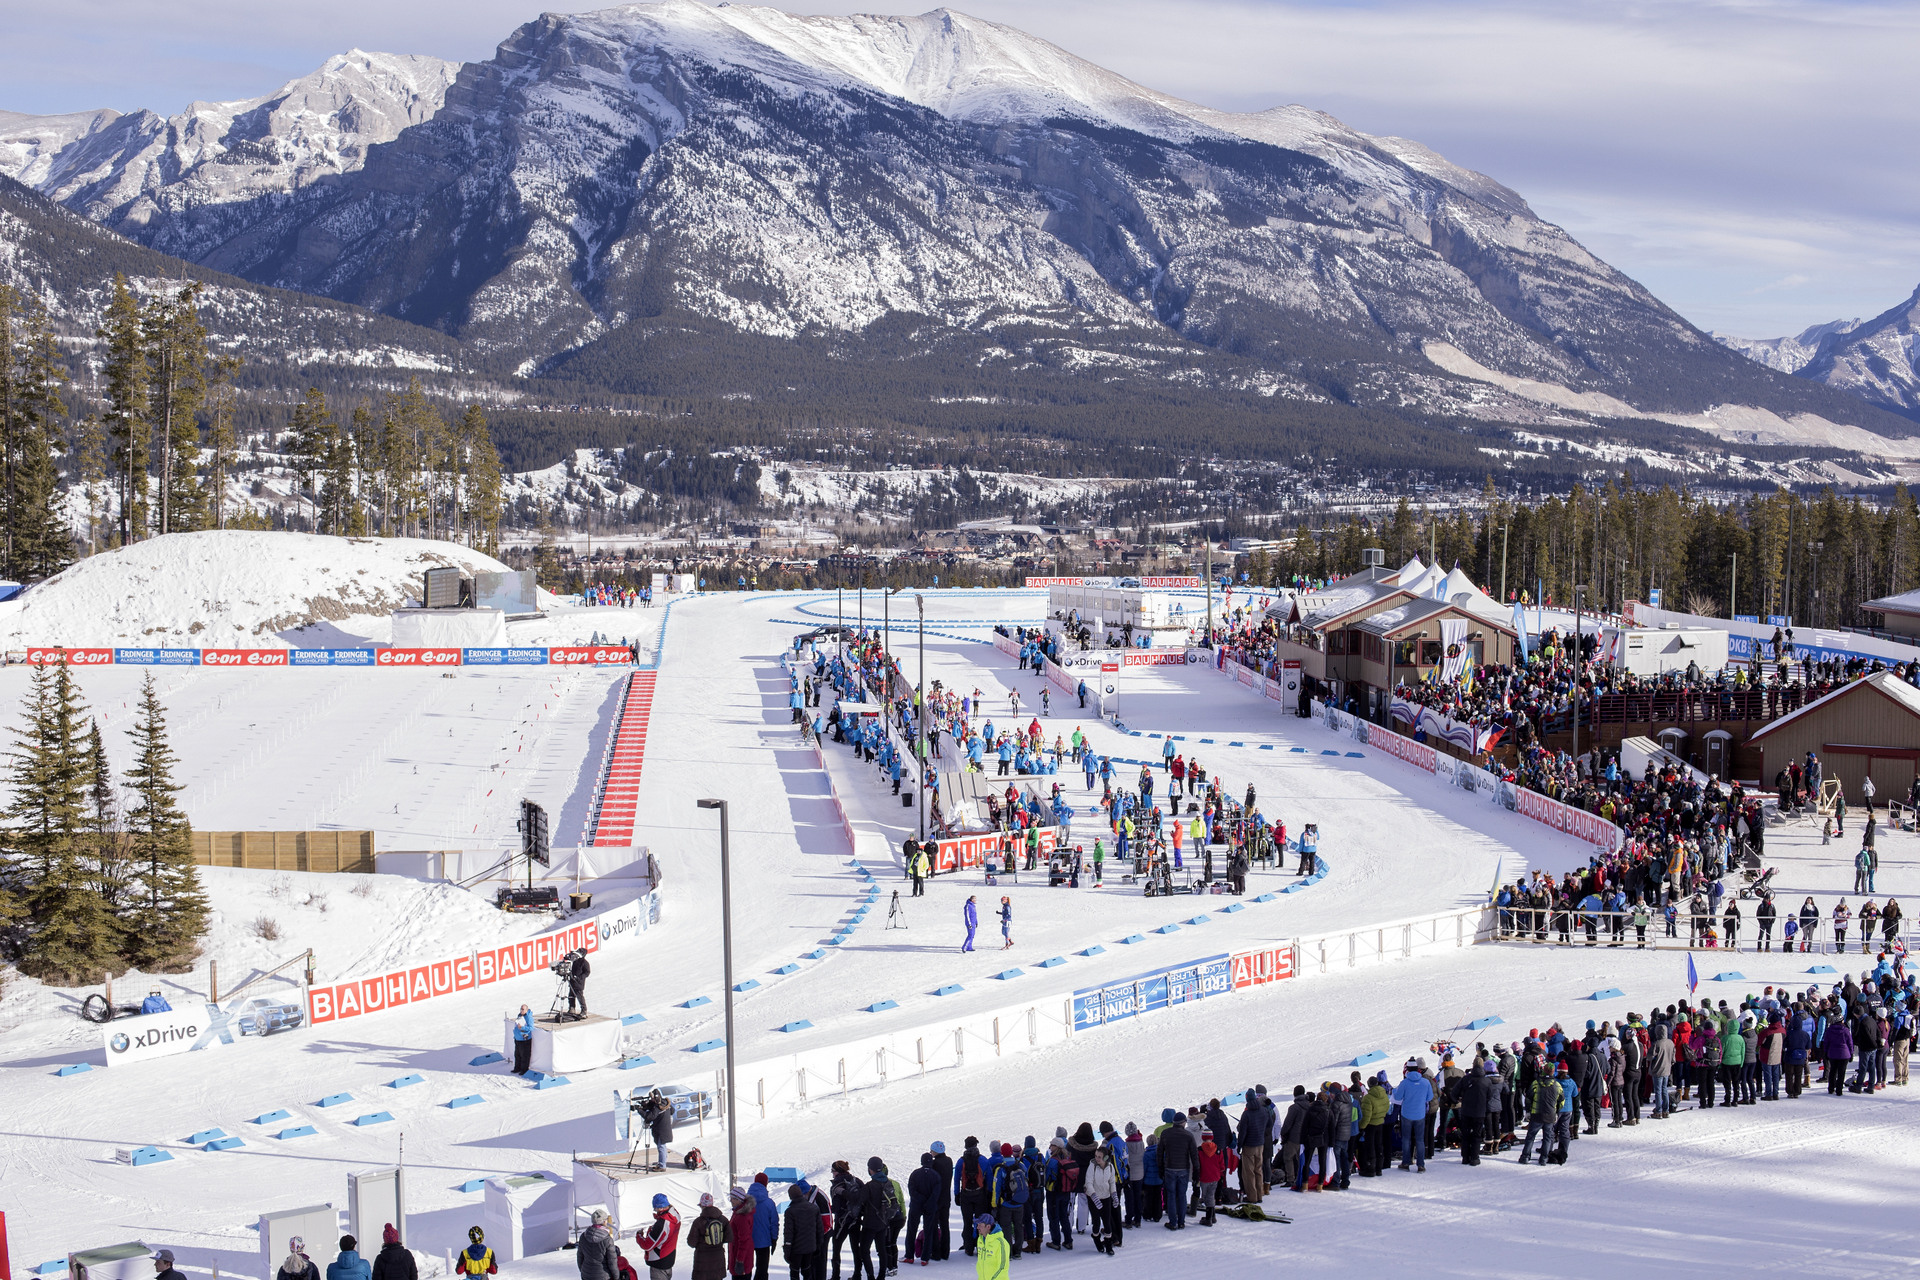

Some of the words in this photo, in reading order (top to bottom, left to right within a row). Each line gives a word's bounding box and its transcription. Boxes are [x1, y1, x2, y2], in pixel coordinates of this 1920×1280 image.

[1142, 577, 1199, 588] BAUHAUS
[120, 650, 154, 658] ERDINGER
[160, 650, 193, 658] ERDINGER
[468, 649, 502, 657] ERDINGER
[508, 649, 541, 657] ERDINGER
[1728, 637, 1747, 654] DKB
[295, 651, 329, 659] ERDINGER
[334, 651, 368, 659] ERDINGER
[1125, 655, 1184, 666] BAUHAUS
[1368, 725, 1401, 757] BAUHAUS
[1401, 738, 1436, 773] BAUHAUS
[1517, 788, 1564, 830] BAUHAUS
[1566, 811, 1616, 851] BAUHAUS
[612, 915, 637, 936] xDrive
[479, 924, 597, 980] BAUHAUS
[312, 963, 473, 1019] BAUHAUS
[135, 1024, 198, 1049] xDrive
